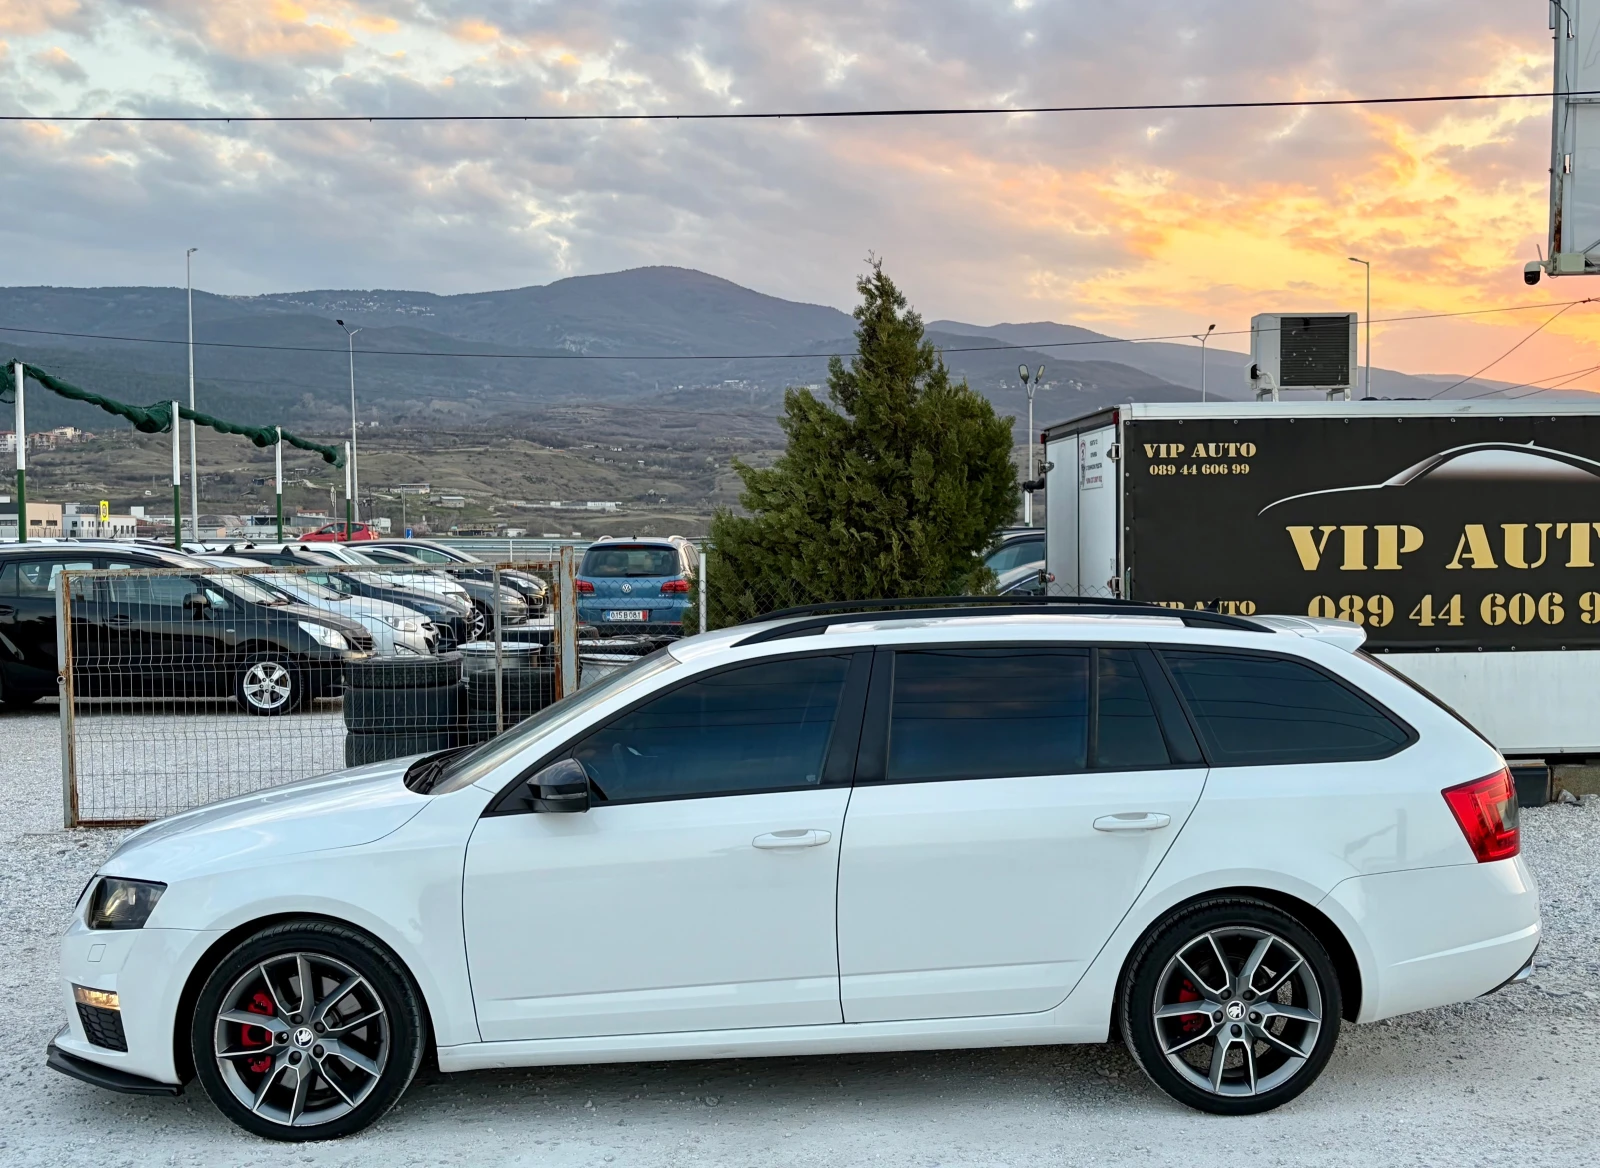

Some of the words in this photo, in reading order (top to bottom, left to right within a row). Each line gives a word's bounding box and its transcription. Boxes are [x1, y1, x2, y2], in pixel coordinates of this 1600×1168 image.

[1143, 443, 1185, 458] VIP
[1191, 442, 1257, 458] AUTO
[1149, 464, 1176, 475] 089
[1180, 464, 1197, 475] 44
[1201, 463, 1228, 475] 606
[1232, 463, 1250, 475] 99
[1285, 524, 1424, 571] VIP
[1307, 594, 1395, 628] 089
[1408, 594, 1465, 627] 44
[1480, 592, 1565, 626] 606
